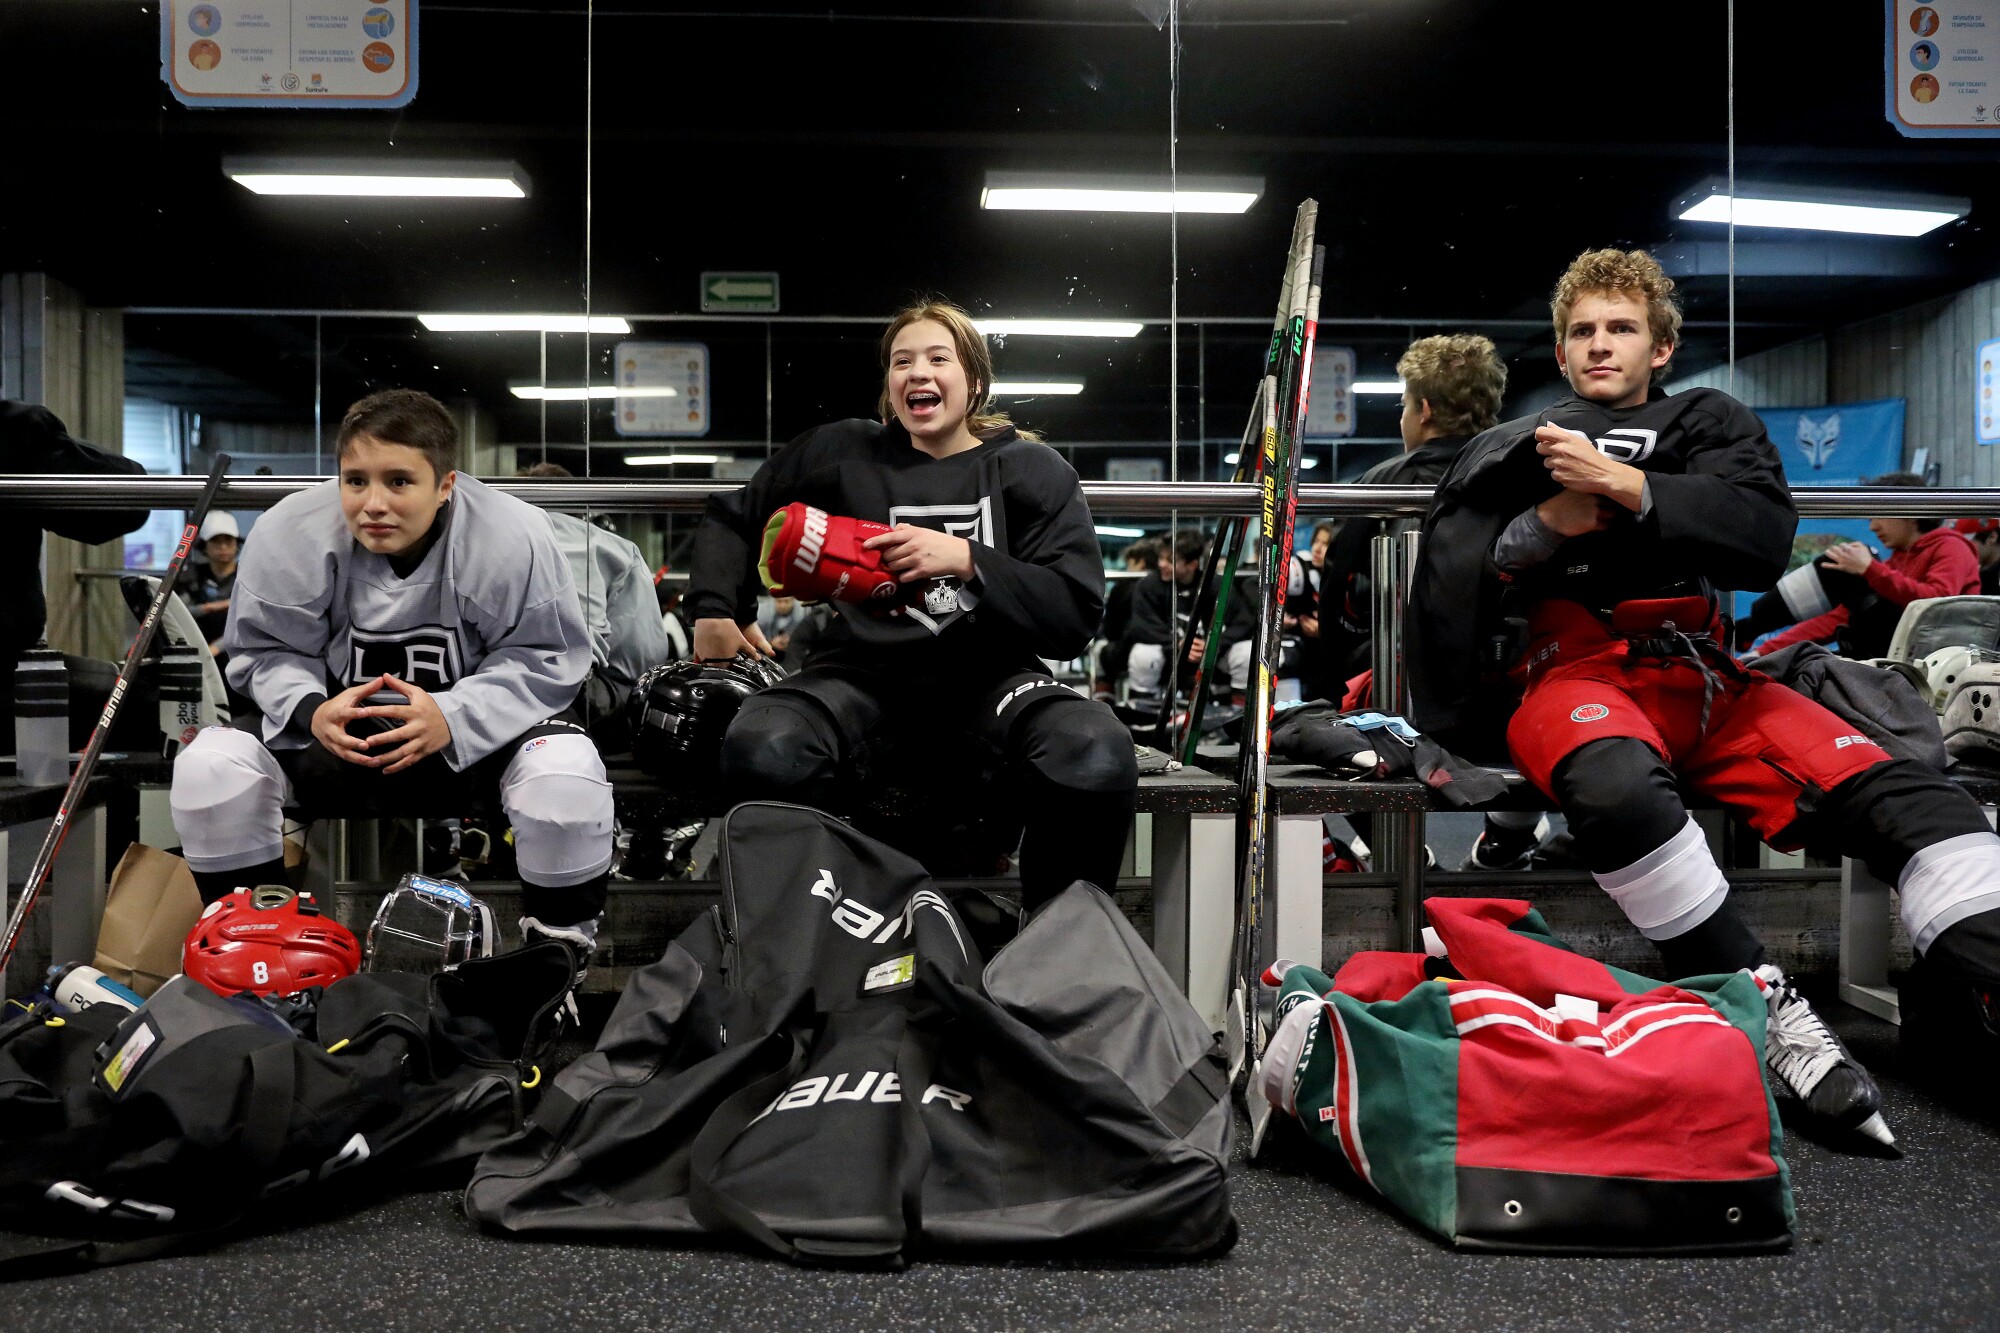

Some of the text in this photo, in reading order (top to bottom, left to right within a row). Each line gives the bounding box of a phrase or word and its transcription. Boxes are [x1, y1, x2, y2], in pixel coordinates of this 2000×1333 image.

[1263, 475, 1274, 538] BAUER
[1277, 486, 1298, 605] JETSPEED
[1566, 564, 1589, 574] S29
[353, 644, 450, 684] LA
[100, 677, 128, 729] BAUER
[414, 881, 469, 904] BAUER
[252, 961, 269, 985] 8
